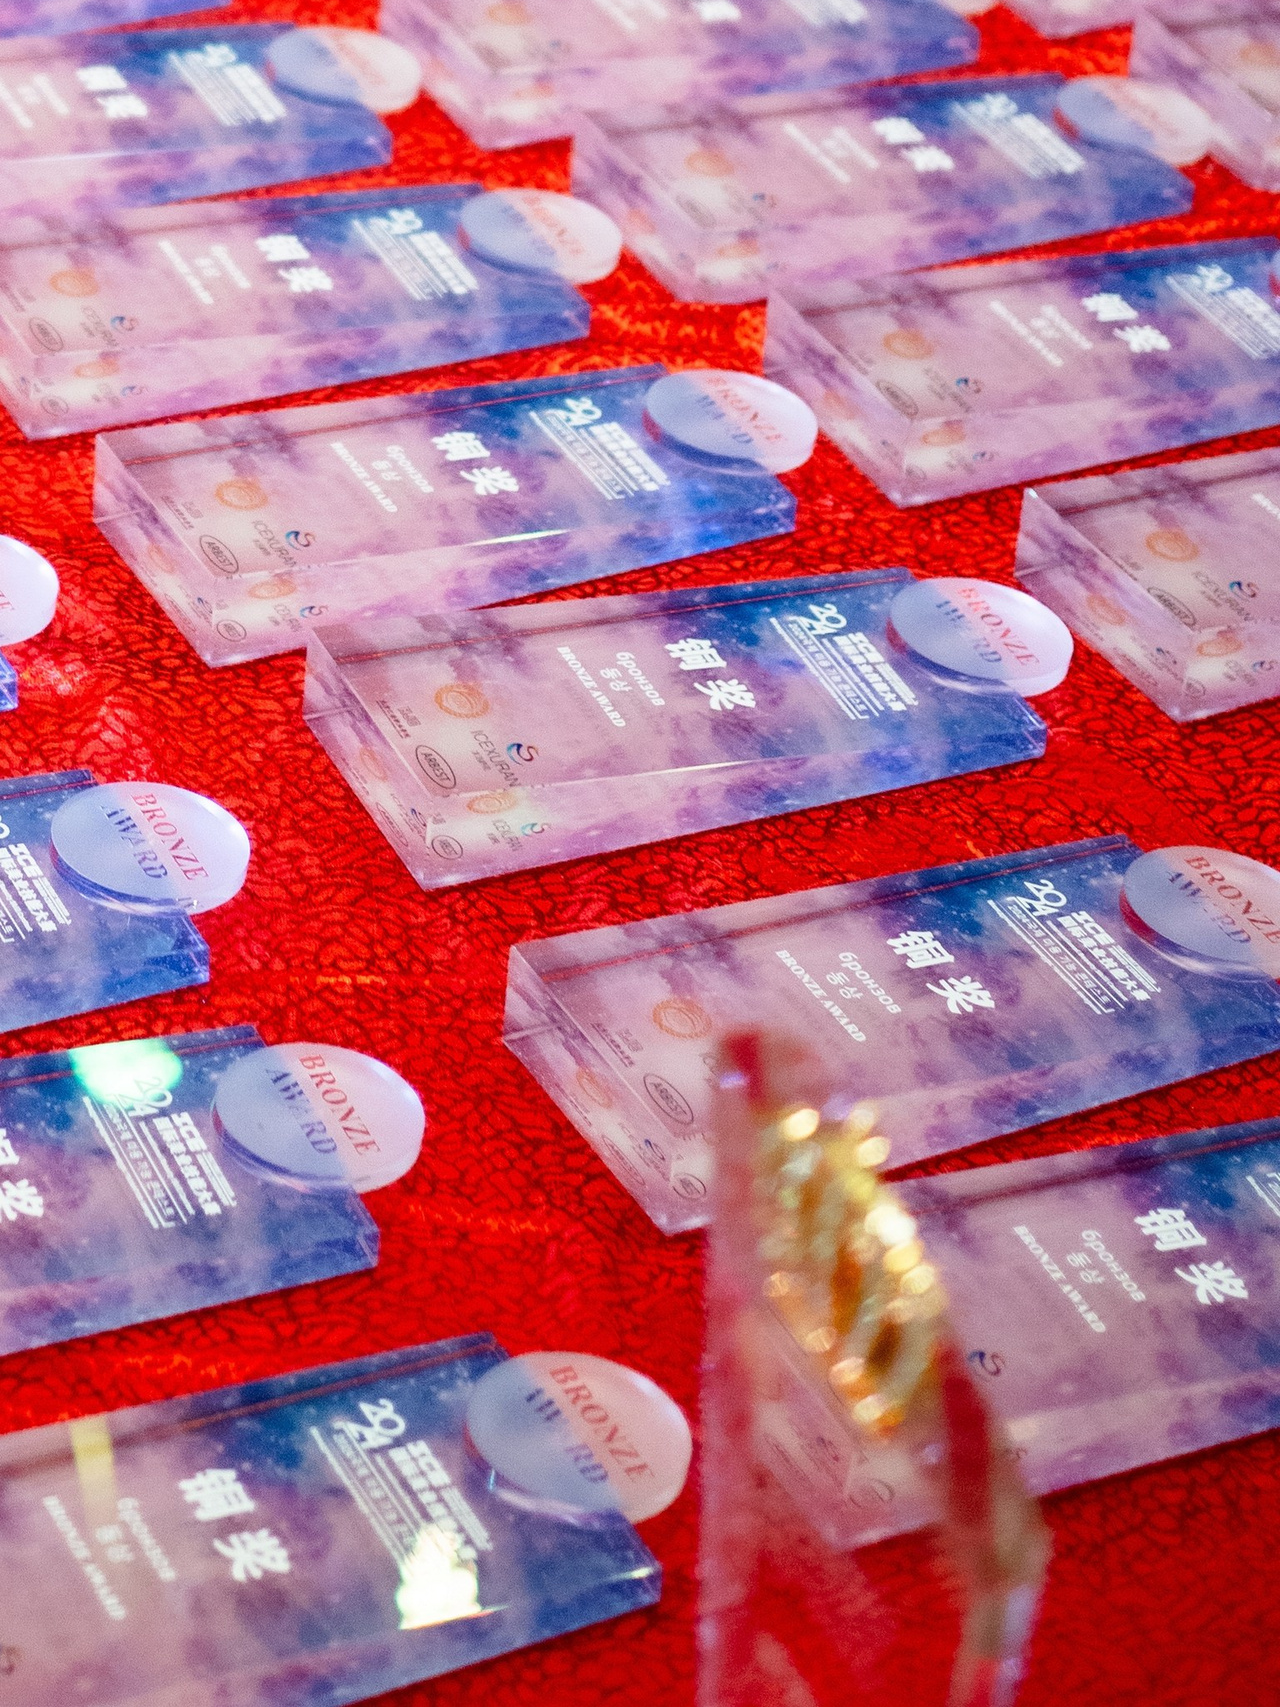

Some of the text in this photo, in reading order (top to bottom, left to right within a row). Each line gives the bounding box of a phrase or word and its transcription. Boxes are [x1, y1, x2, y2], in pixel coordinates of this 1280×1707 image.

[432, 432, 519, 495] 铜奖
[958, 588, 1040, 666] BRONZE
[557, 646, 626, 727] BRONZE AWARD
[600, 668, 632, 692] 동상
[665, 638, 756, 710] 铜奖
[422, 752, 451, 782] ARBEST
[129, 793, 209, 881] BRONZE
[1016, 879, 1067, 917] 2024
[1071, 910, 1115, 945] ICE
[775, 950, 866, 1042] BRONZE AWARD
[826, 971, 863, 999] 동상
[839, 952, 901, 1014] бронзов
[887, 931, 995, 1014] 铜奖
[1057, 916, 1151, 1001] 国际美业技能大赛
[299, 1054, 381, 1156] BRONZE
[1134, 1208, 1249, 1305] 铜奖
[550, 1365, 655, 1482] BRONZE
[179, 1469, 291, 1582] 铜奖
